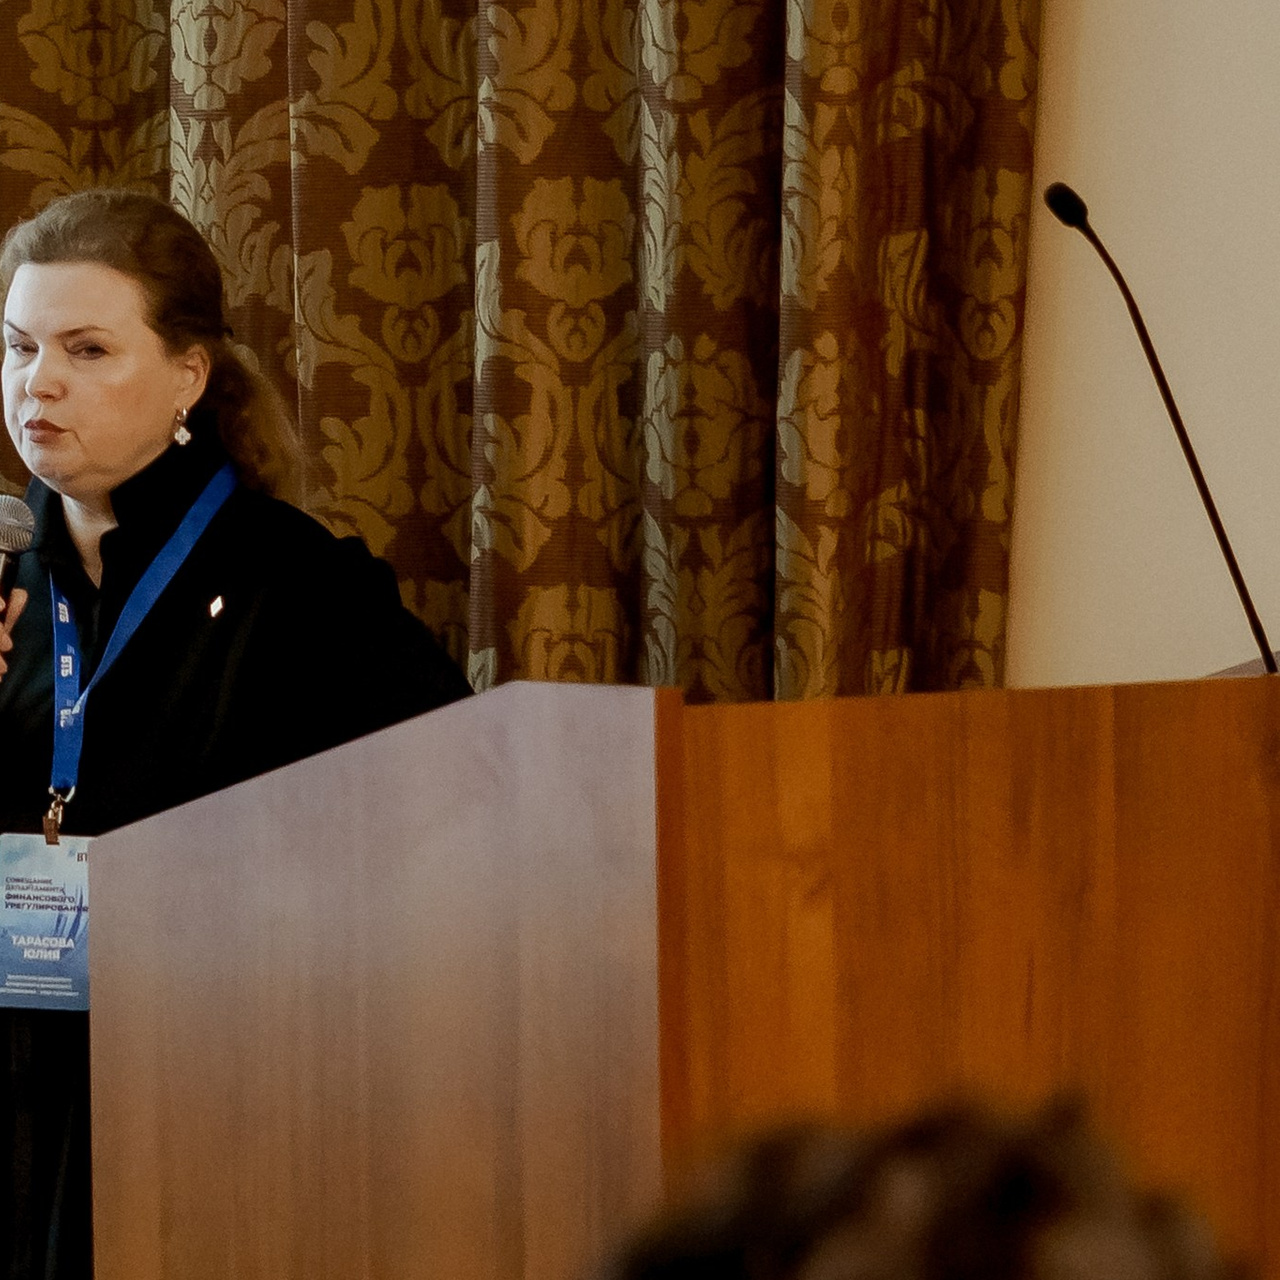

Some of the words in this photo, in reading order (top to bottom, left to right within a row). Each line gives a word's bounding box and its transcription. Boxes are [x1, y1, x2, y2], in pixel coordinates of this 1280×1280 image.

[60, 655, 73, 678] ВТБ
[77, 852, 88, 862] ВТ
[5, 892, 75, 903] ФИНАНСОВОГО
[12, 935, 75, 949] ТАРАСОВА
[24, 948, 60, 961] ЮЛИЯ
